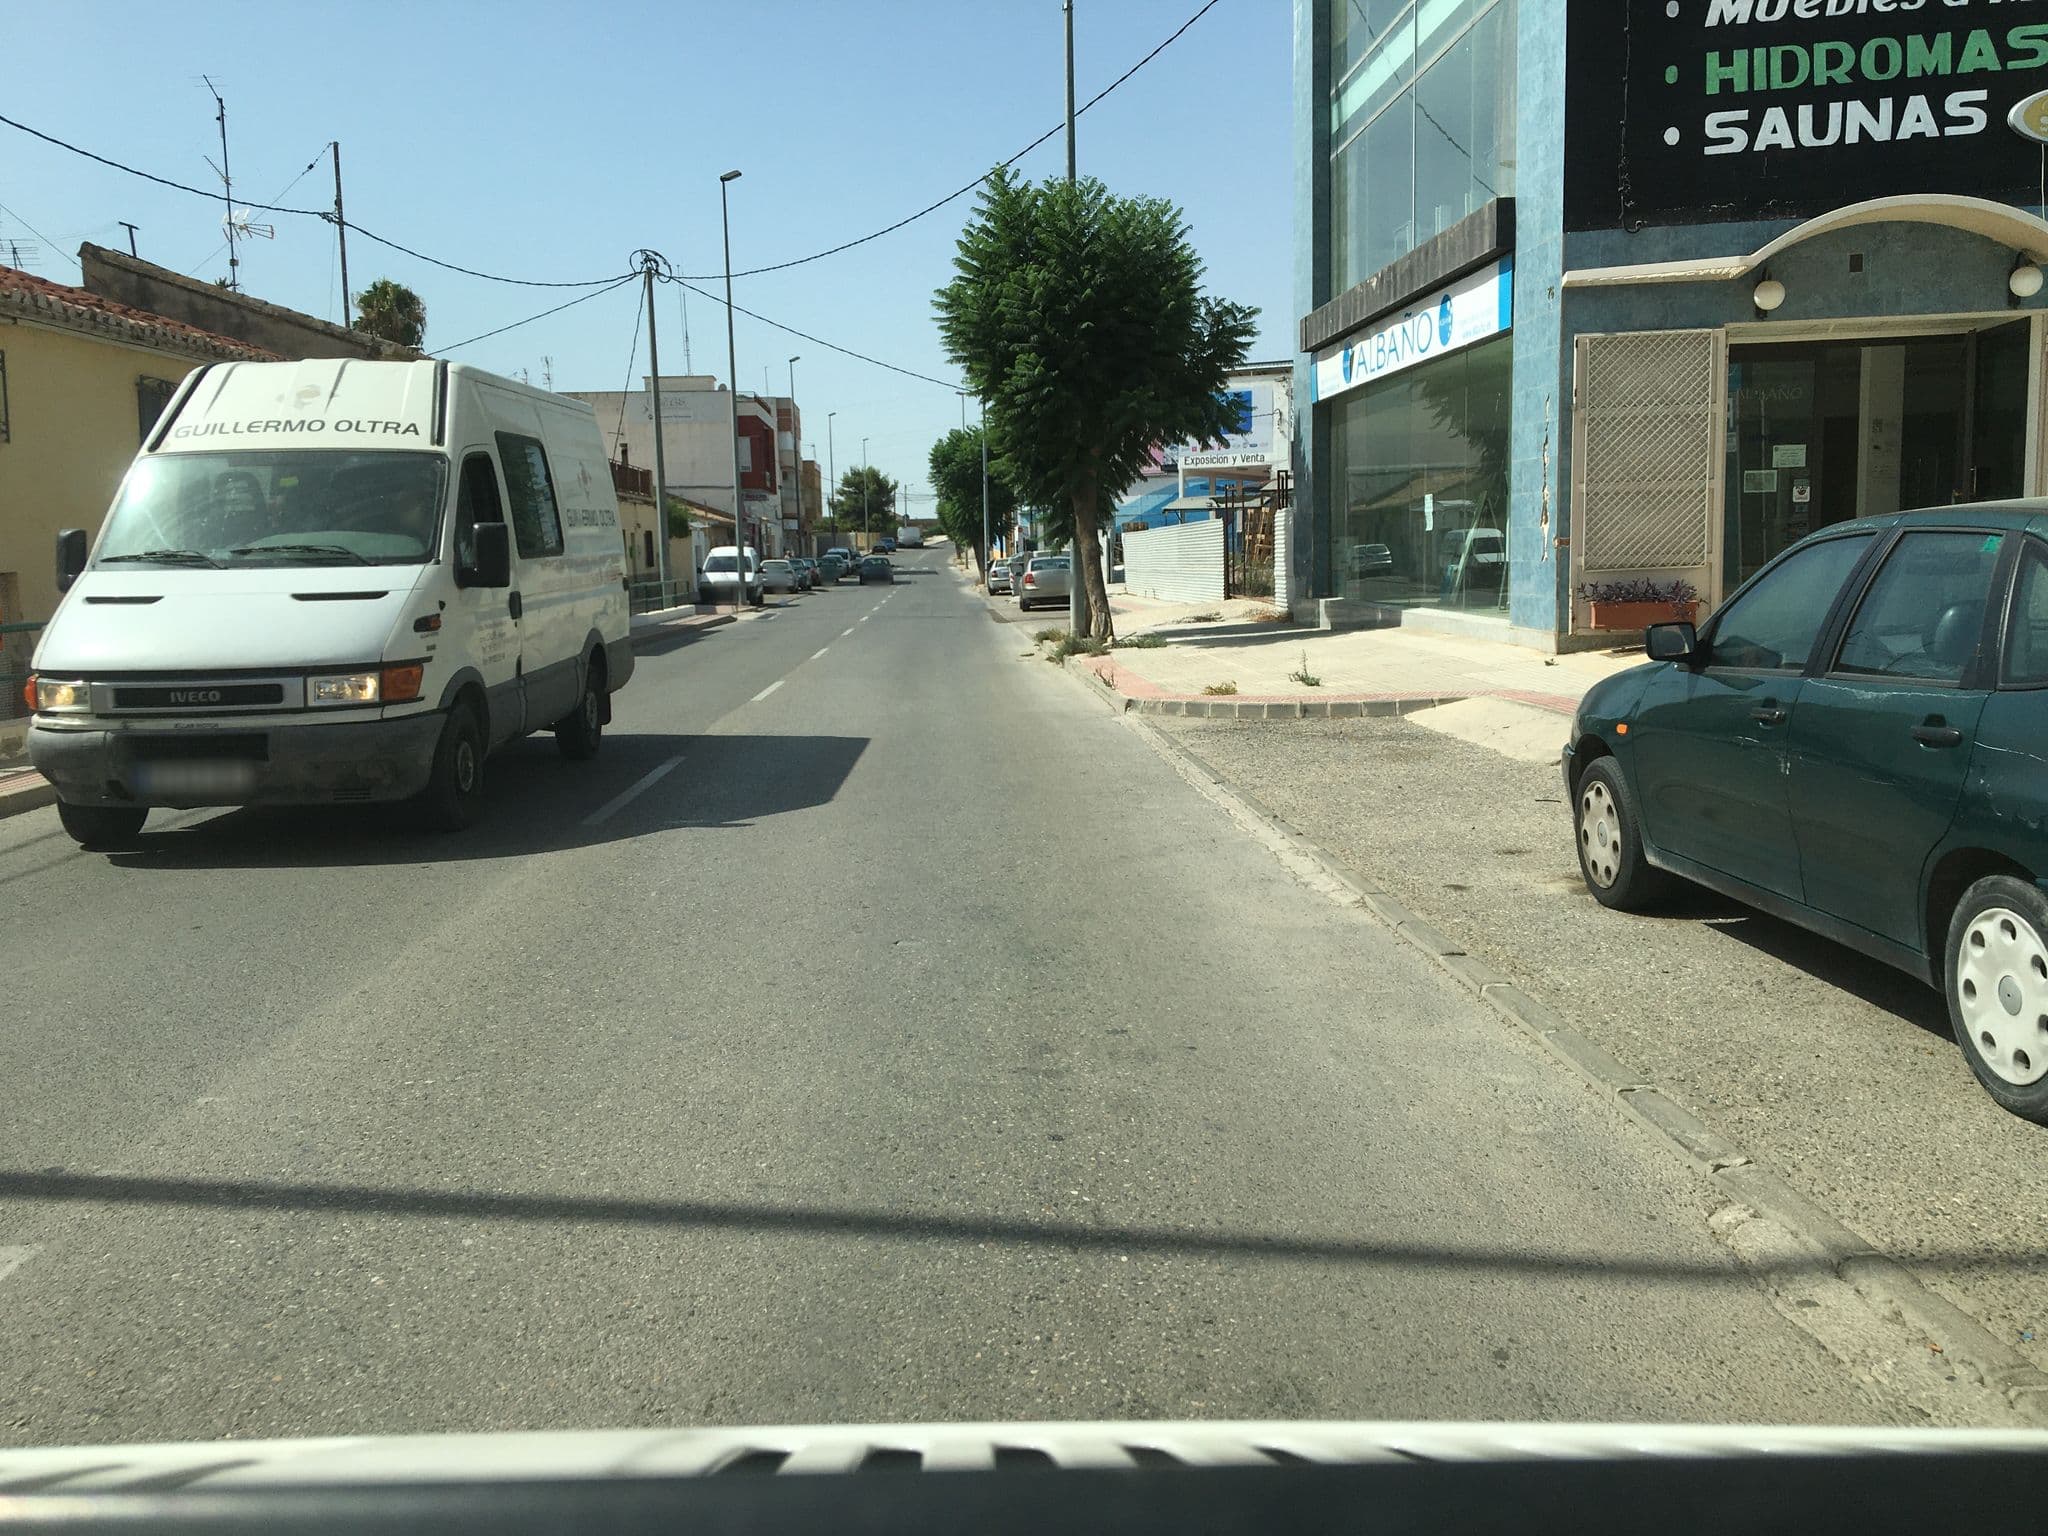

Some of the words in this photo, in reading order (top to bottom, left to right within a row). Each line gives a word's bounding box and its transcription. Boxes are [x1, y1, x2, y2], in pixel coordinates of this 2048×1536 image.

[1706, 24, 2048, 95] HIDROMAS
[1704, 89, 1987, 155] SAUNAS
[1356, 312, 1433, 379] ALBAÑO
[174, 418, 326, 439] GUILLERMO
[334, 419, 420, 436] OLTRA
[1231, 456, 1238, 465] y
[1240, 453, 1265, 463] Venta
[170, 689, 221, 703] IVECO
